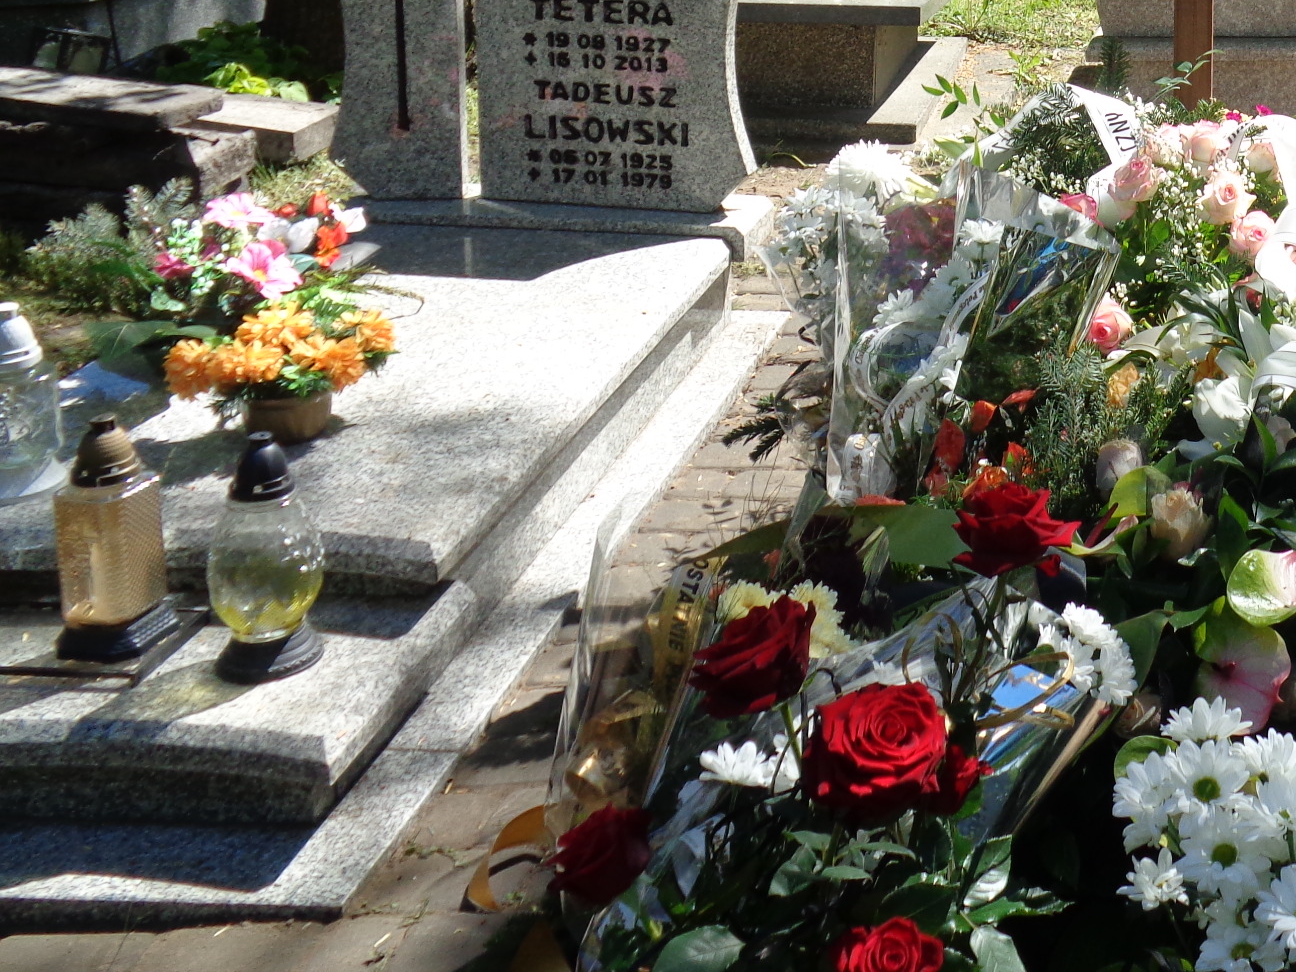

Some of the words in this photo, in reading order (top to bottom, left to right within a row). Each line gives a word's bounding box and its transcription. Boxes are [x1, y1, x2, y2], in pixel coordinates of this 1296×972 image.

[615, 35, 671, 53] 1927
[582, 53, 606, 70] 10
[614, 55, 669, 73] 2013
[533, 79, 677, 108] TADEUSZ
[523, 113, 690, 147] LISOWSKI
[584, 150, 612, 166] 07
[620, 152, 673, 171] 1925
[551, 167, 576, 184] 17
